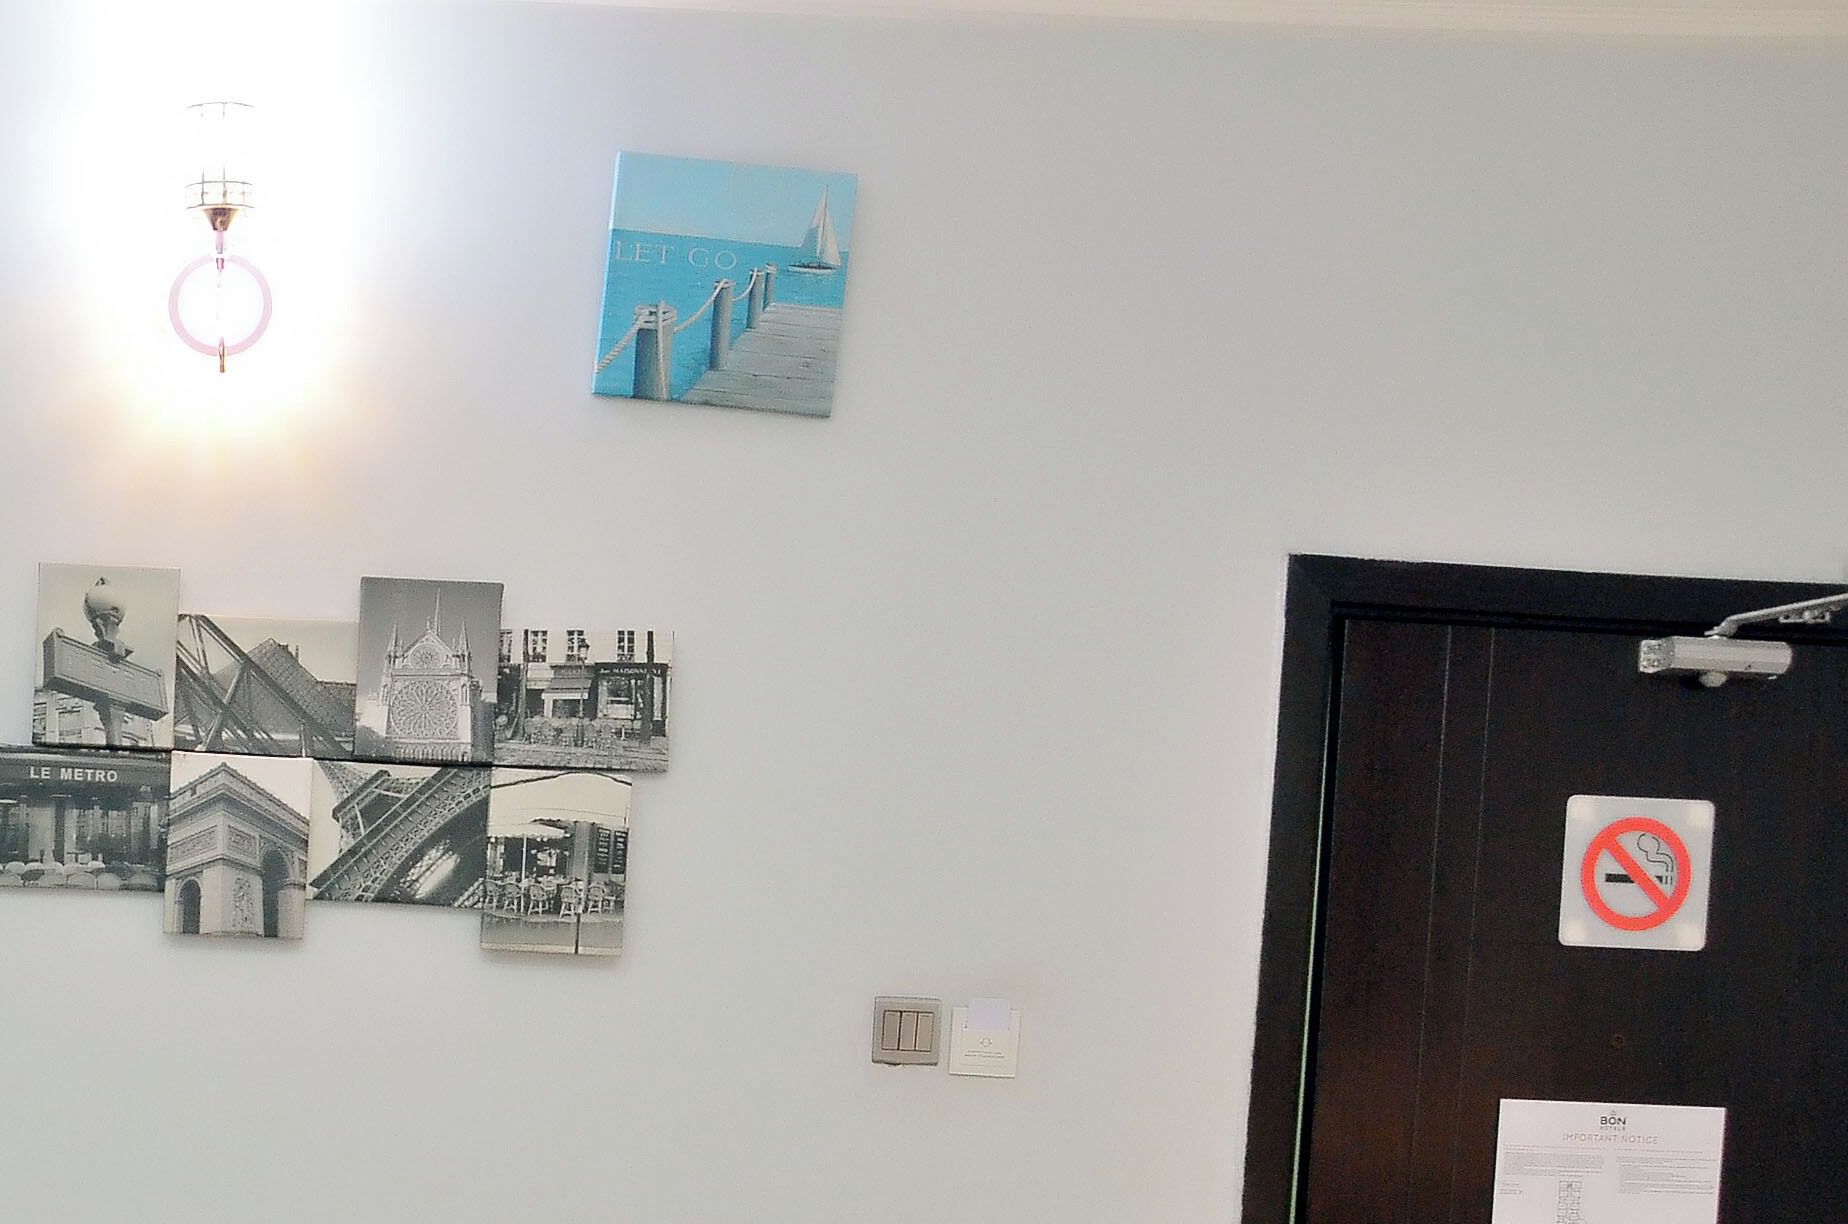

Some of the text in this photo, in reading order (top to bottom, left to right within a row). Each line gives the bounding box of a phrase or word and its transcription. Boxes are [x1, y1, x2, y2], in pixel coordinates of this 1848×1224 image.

[616, 241, 738, 270] LET GO
[30, 766, 118, 782] LE METRO
[1600, 1116, 1626, 1125] BON
[1563, 1133, 1658, 1144] IMPORTANT NOTICE
